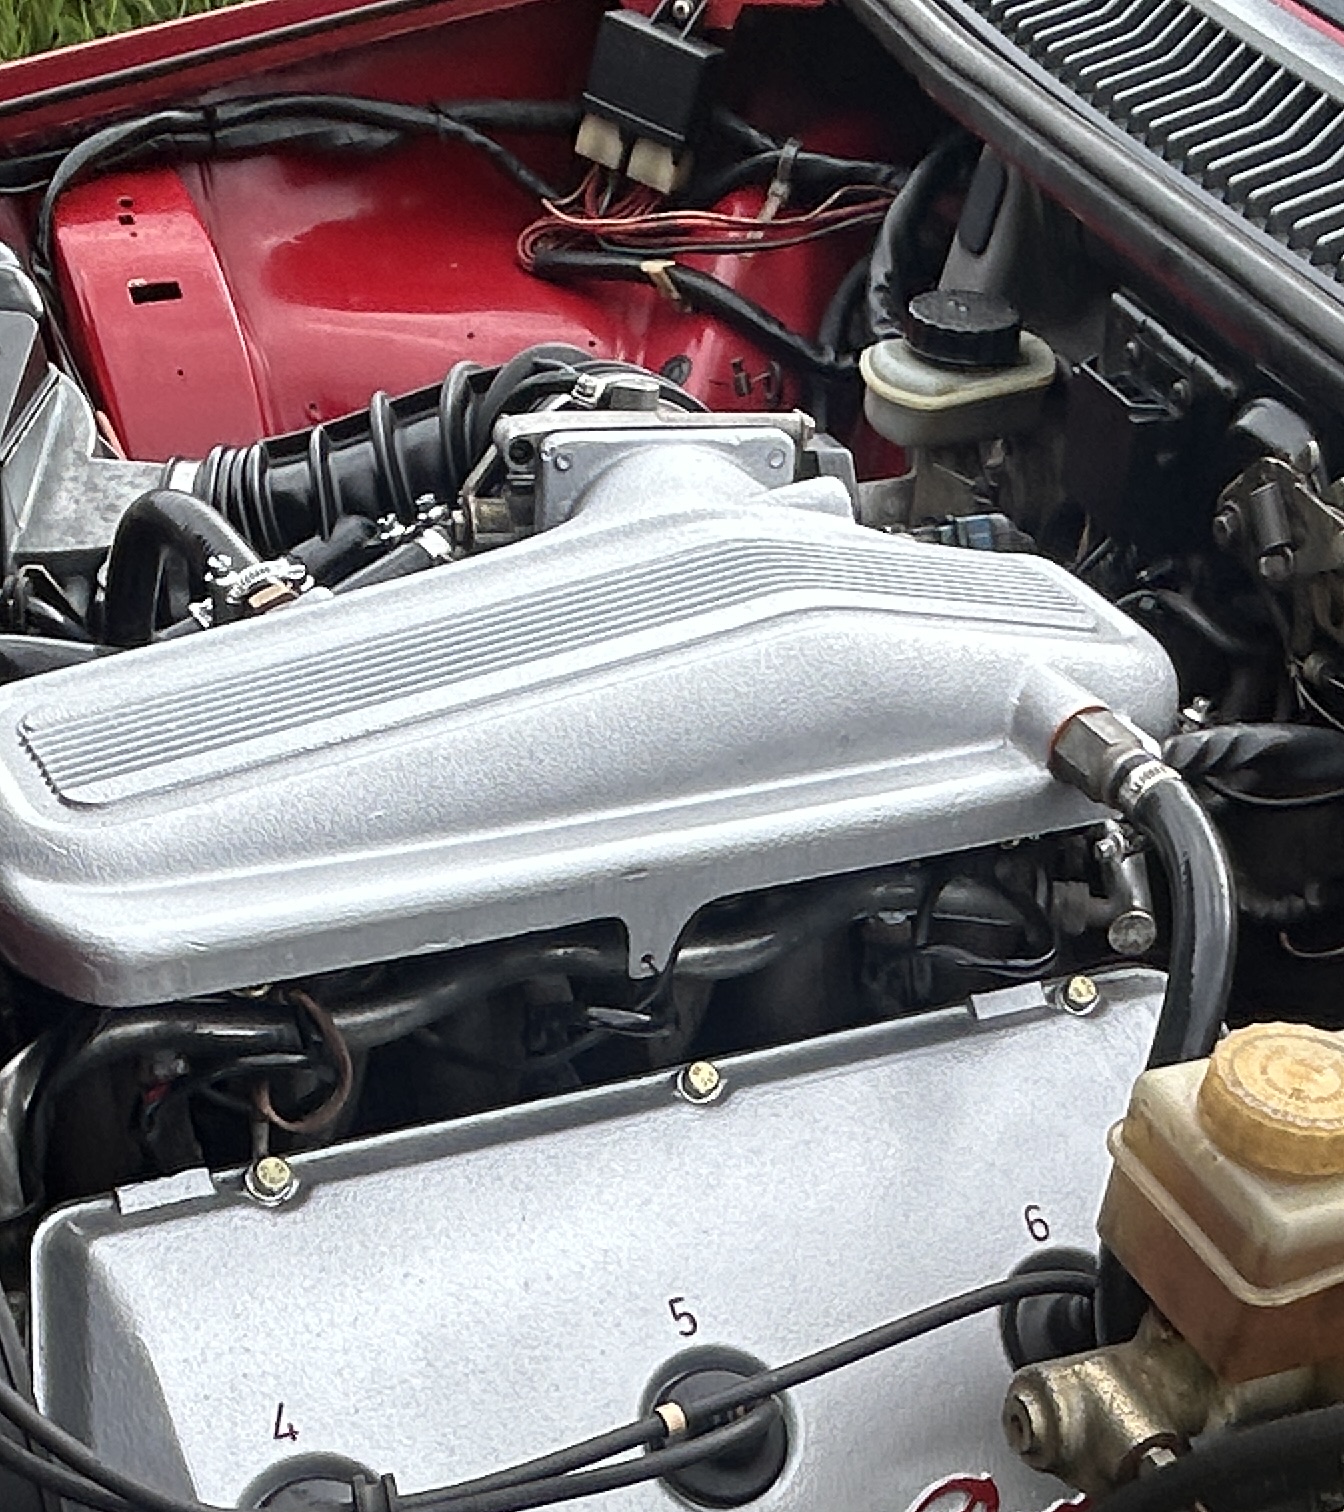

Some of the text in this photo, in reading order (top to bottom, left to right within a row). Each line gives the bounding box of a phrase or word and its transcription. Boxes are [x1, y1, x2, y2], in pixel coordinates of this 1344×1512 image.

[1024, 1204, 1051, 1242] 6
[668, 1296, 699, 1337] 5
[271, 1401, 301, 1443] 4
